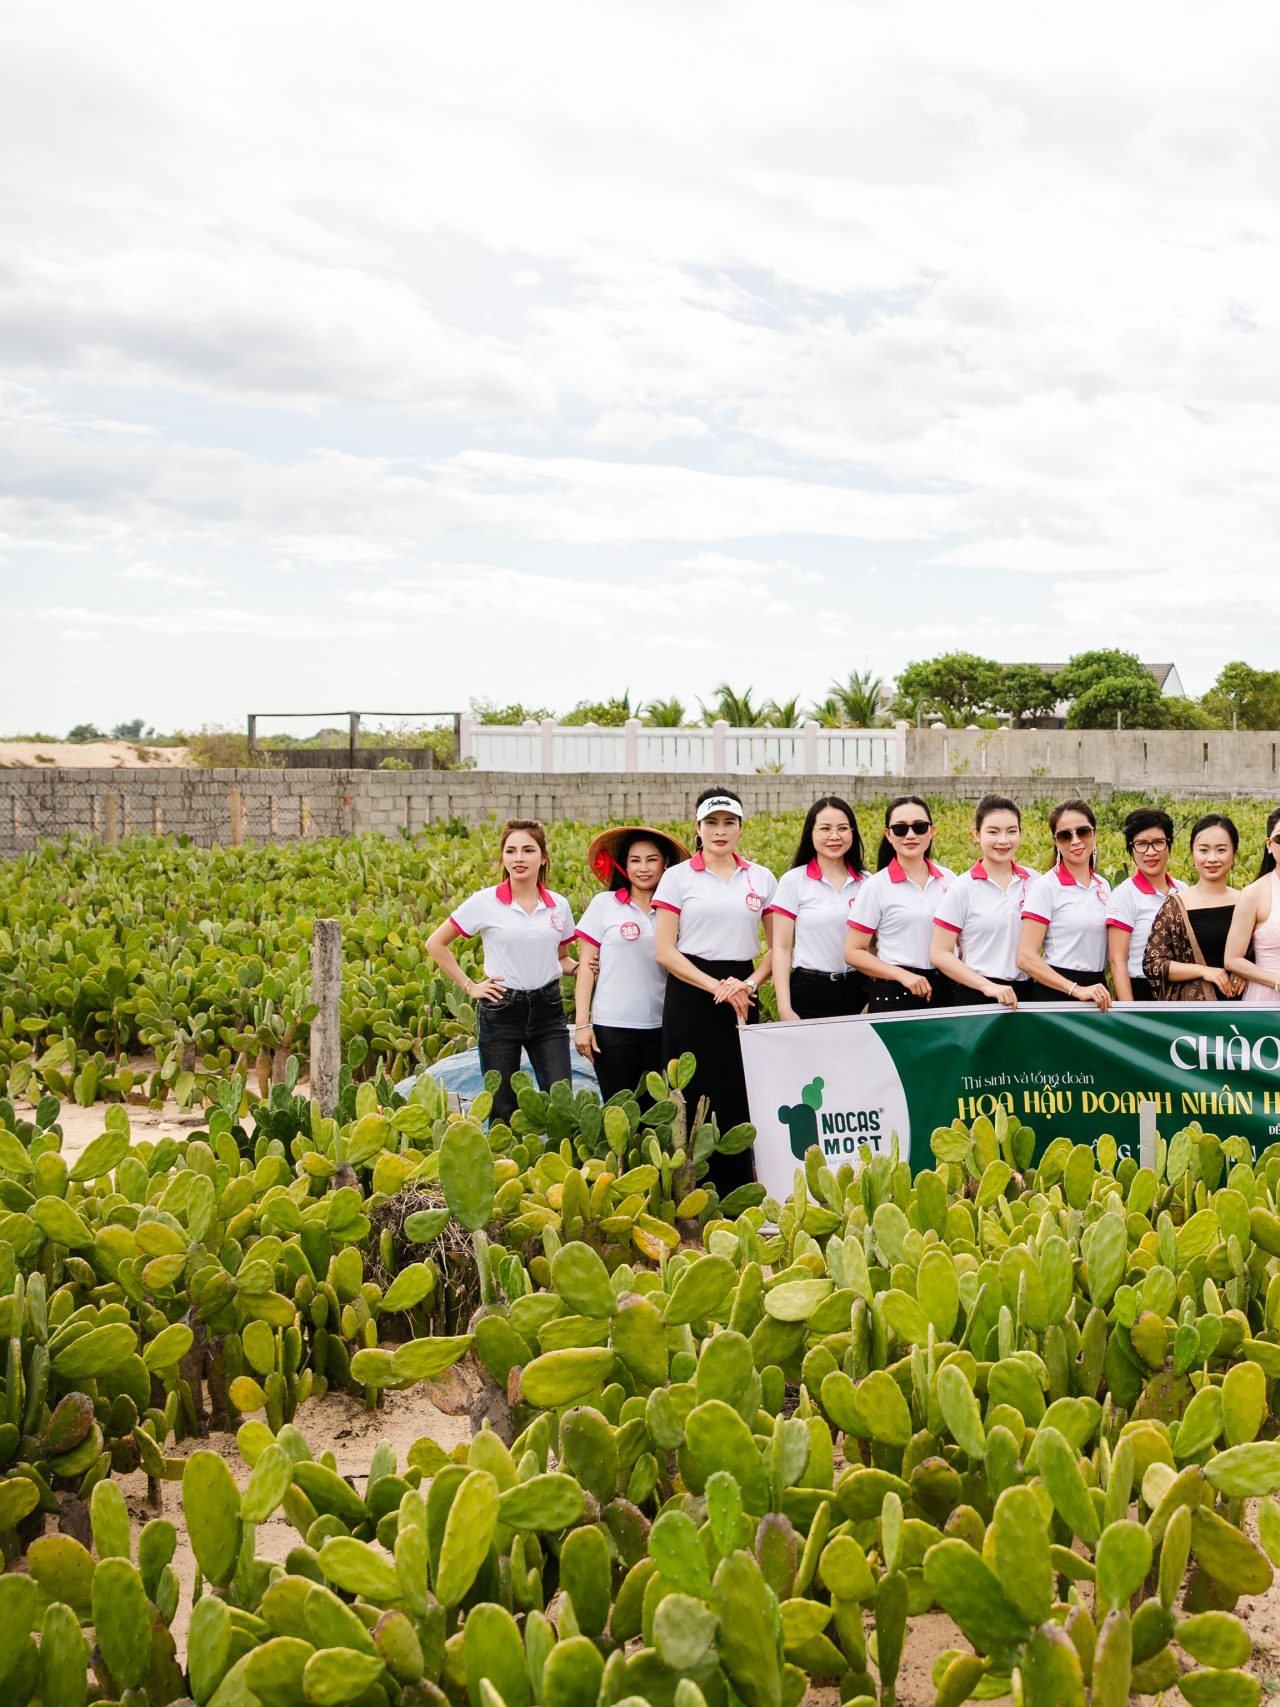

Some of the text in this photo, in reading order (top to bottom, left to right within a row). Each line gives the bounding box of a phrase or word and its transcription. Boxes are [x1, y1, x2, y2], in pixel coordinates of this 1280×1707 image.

[984, 1072, 1011, 1086] sinh
[1013, 1072, 1029, 1084] và
[957, 1091, 1015, 1120] HOA
[1023, 1084, 1072, 1119] HẬU
[1181, 1084, 1253, 1115] NHÂN
